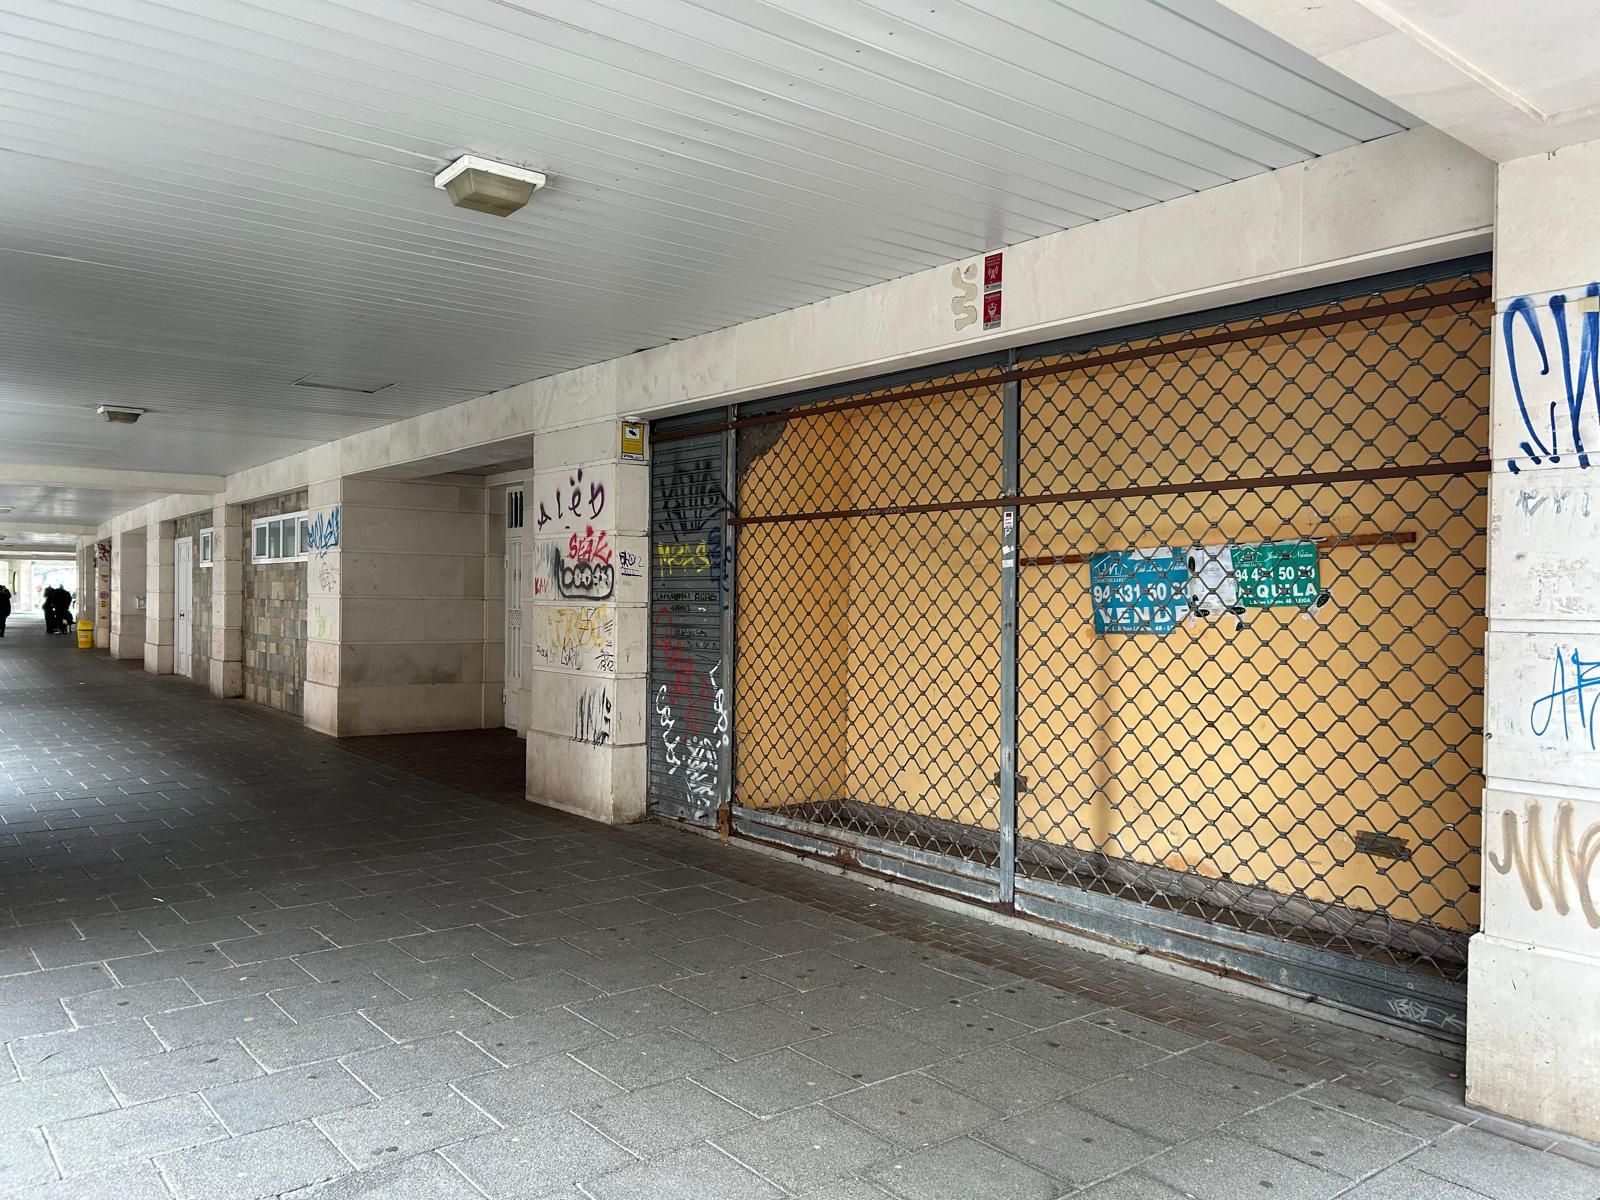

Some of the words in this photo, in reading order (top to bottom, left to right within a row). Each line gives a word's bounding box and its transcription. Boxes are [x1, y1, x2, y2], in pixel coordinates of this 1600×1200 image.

[1235, 568, 1248, 581] 94
[1278, 566, 1295, 580] 50
[1093, 585, 1112, 603] 94
[1147, 582, 1167, 601] 50
